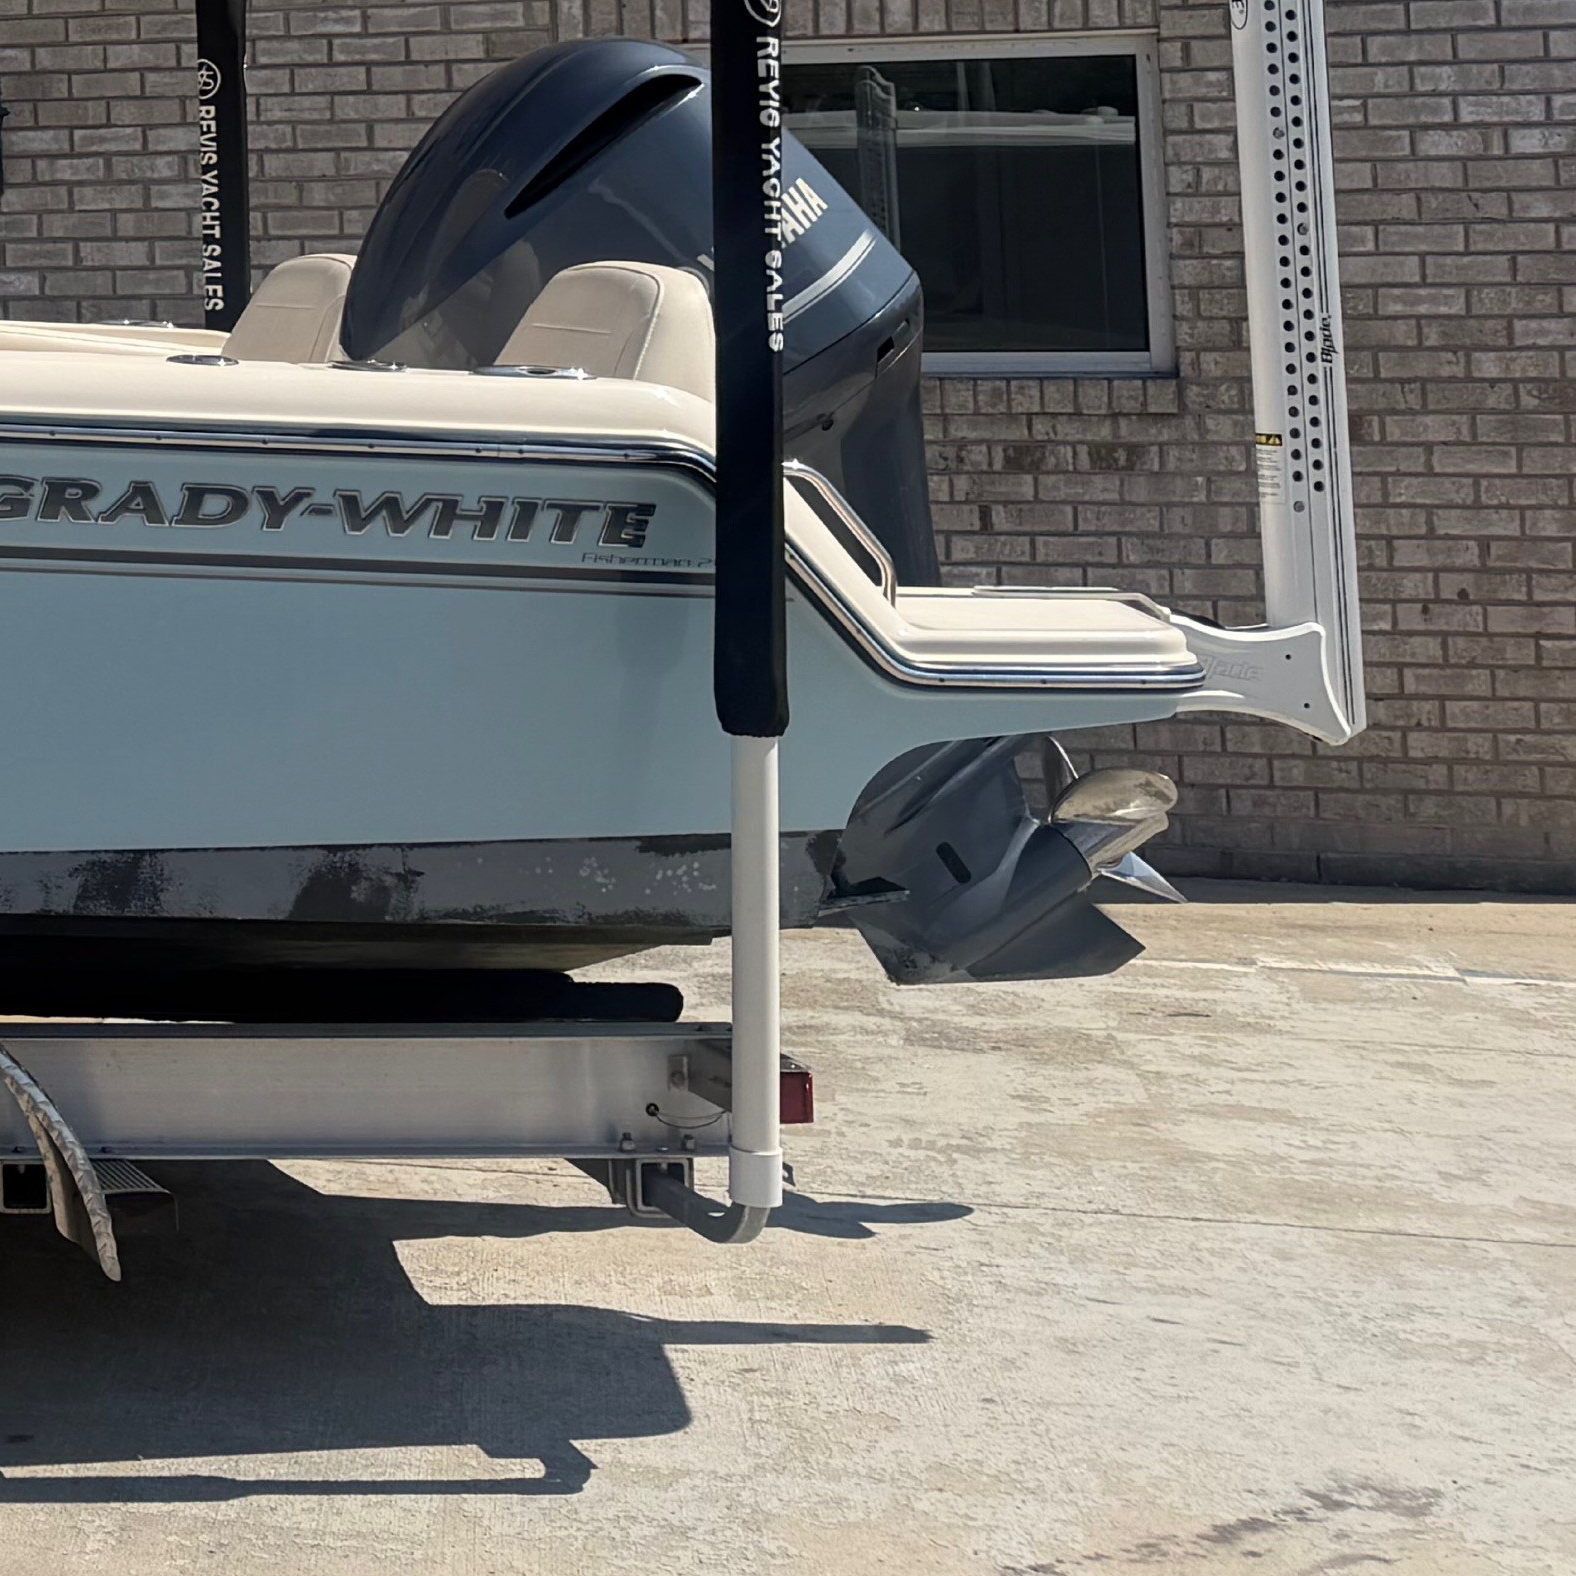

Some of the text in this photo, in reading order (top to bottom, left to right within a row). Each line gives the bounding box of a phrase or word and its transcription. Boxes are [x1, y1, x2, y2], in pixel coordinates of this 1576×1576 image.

[199, 105, 224, 312] REVIS YACHT SALES
[760, 137, 782, 242] YACHT
[764, 249, 784, 354] SALES
